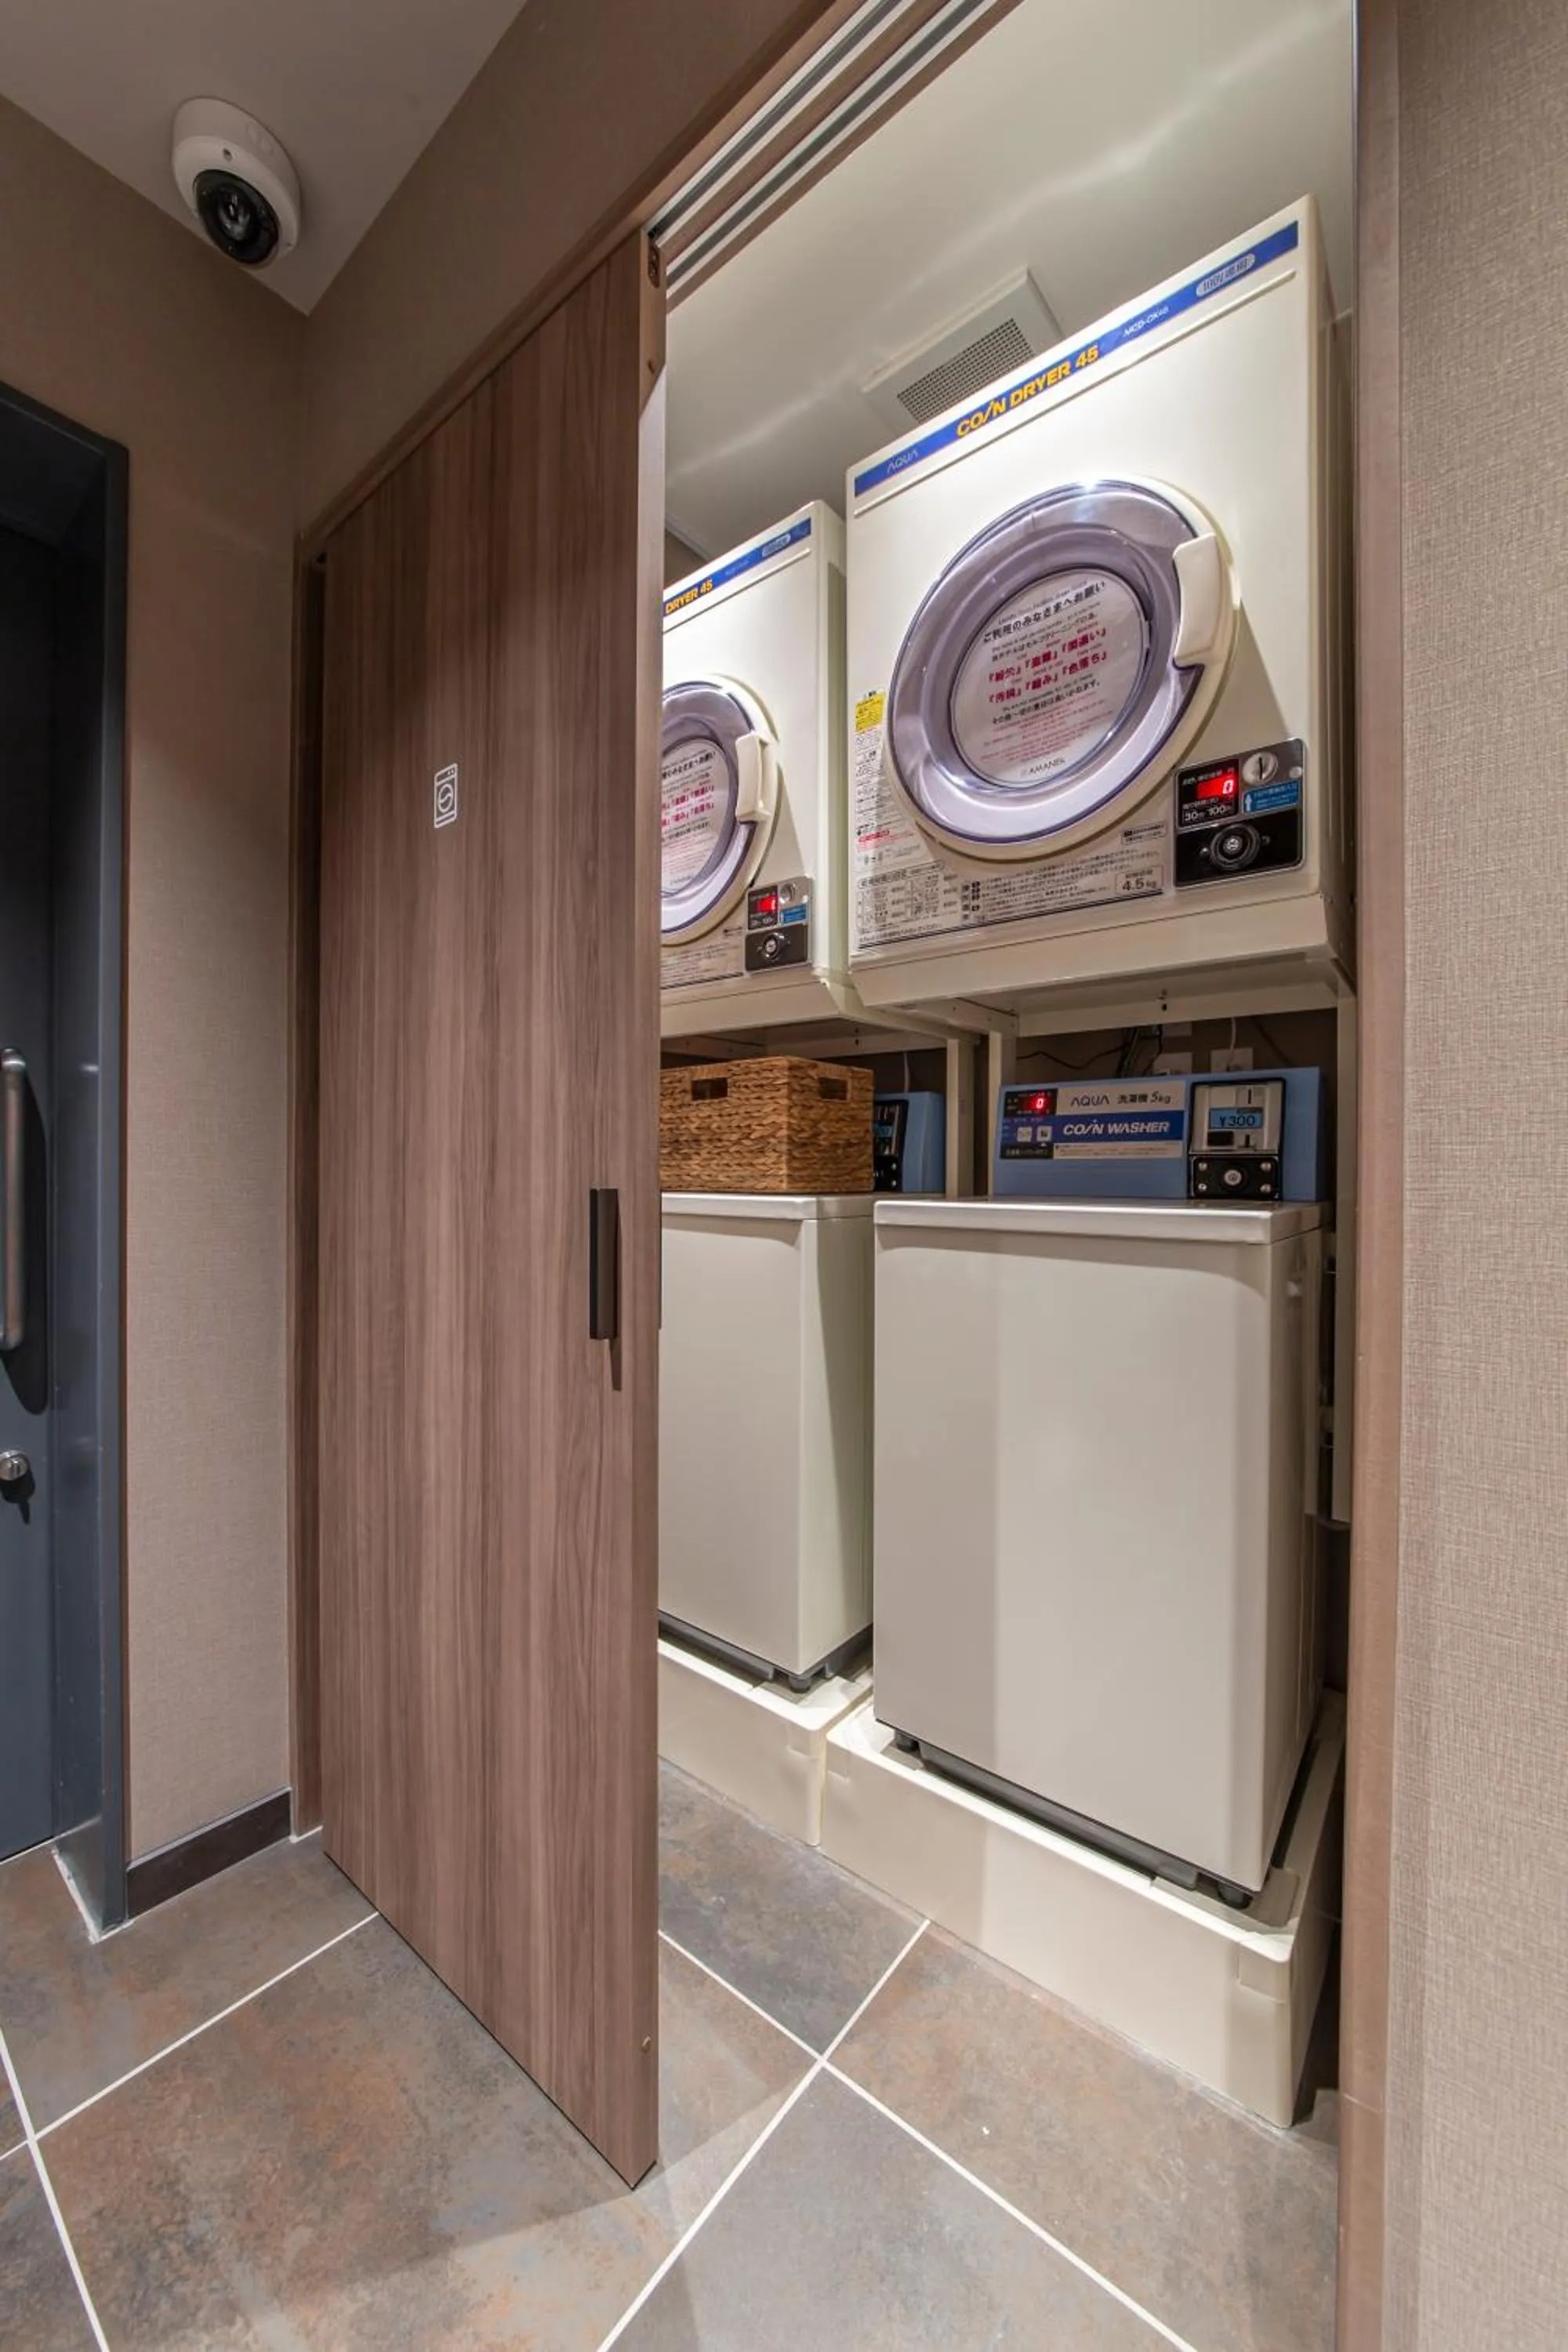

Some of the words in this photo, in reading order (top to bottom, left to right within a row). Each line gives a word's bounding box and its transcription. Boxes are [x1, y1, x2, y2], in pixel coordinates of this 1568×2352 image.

[887, 449, 918, 474] AQUA
[956, 401, 1007, 439] COIN
[1010, 361, 1071, 408] DRYER
[1075, 345, 1099, 368] 45
[666, 587, 698, 615] DRYER
[700, 579, 713, 594] 45
[1222, 779, 1233, 794] 0
[1070, 1094, 1109, 1106] AQUA
[1062, 1120, 1103, 1135] COIN
[1108, 1121, 1170, 1134] WASHER
